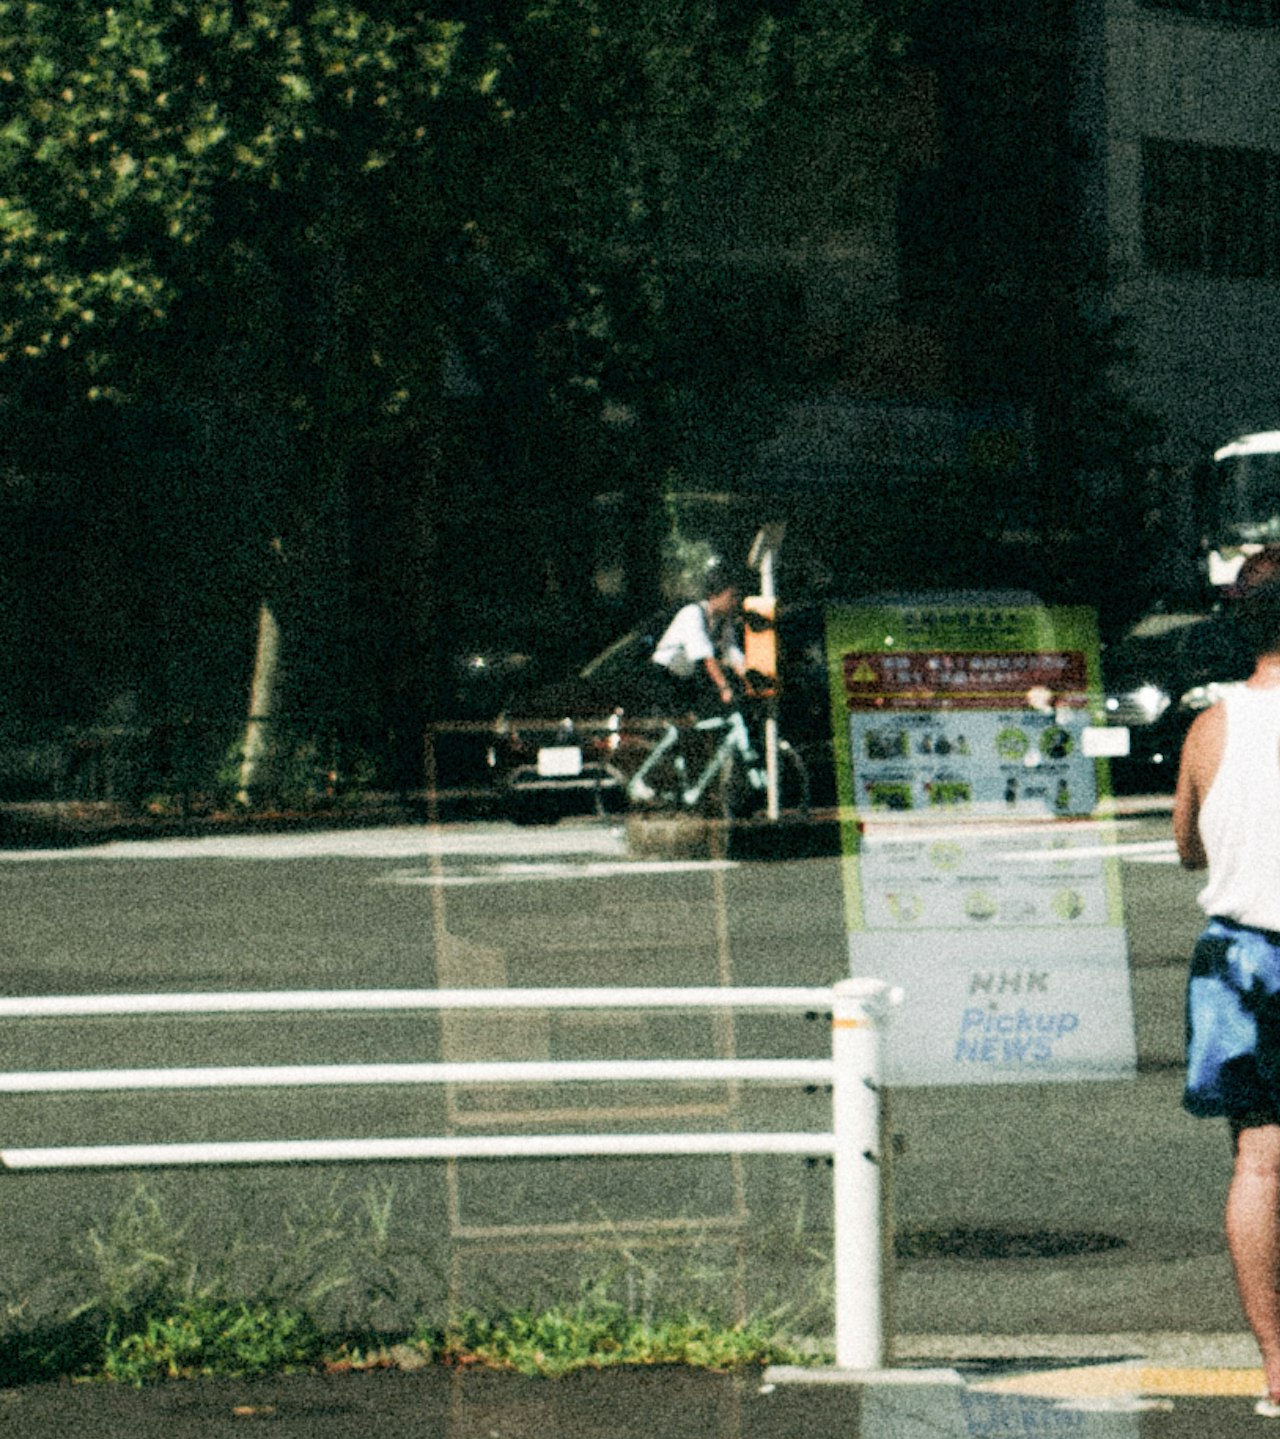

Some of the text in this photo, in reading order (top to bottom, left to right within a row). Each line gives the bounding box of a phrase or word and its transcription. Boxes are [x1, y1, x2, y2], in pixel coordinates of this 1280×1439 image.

[969, 972, 1048, 994] NHK
[961, 1004, 1079, 1037] Pickup
[955, 1037, 1052, 1061] NEWS
